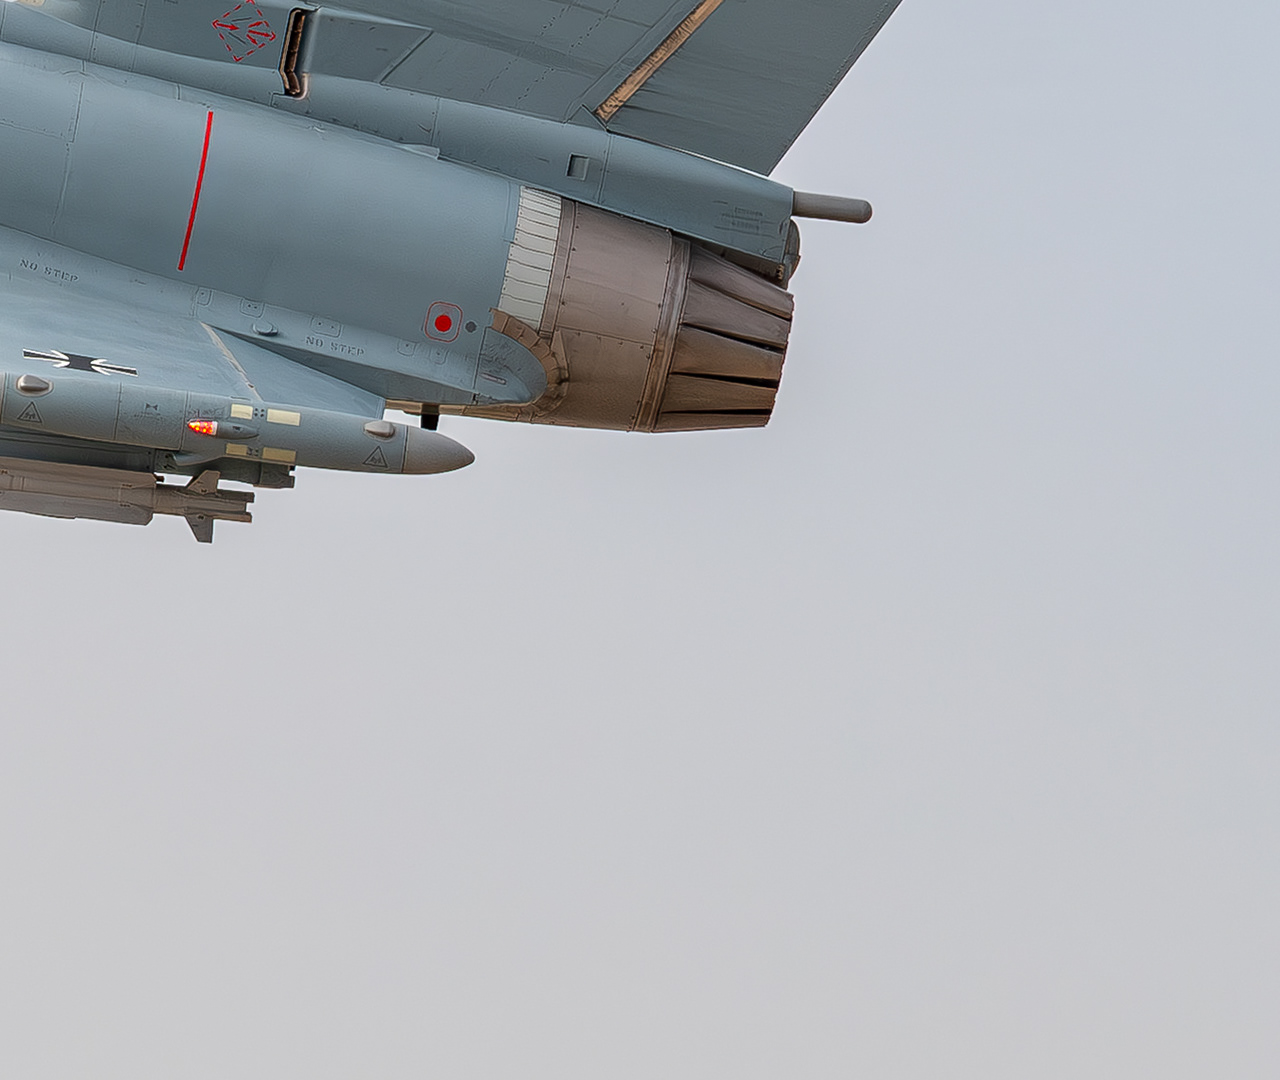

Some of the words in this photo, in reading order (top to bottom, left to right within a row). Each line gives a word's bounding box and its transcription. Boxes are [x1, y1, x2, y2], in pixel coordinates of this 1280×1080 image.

[18, 257, 39, 272] NO
[43, 265, 80, 283] STEP
[305, 336, 325, 348] NO
[330, 342, 366, 357] STEP
